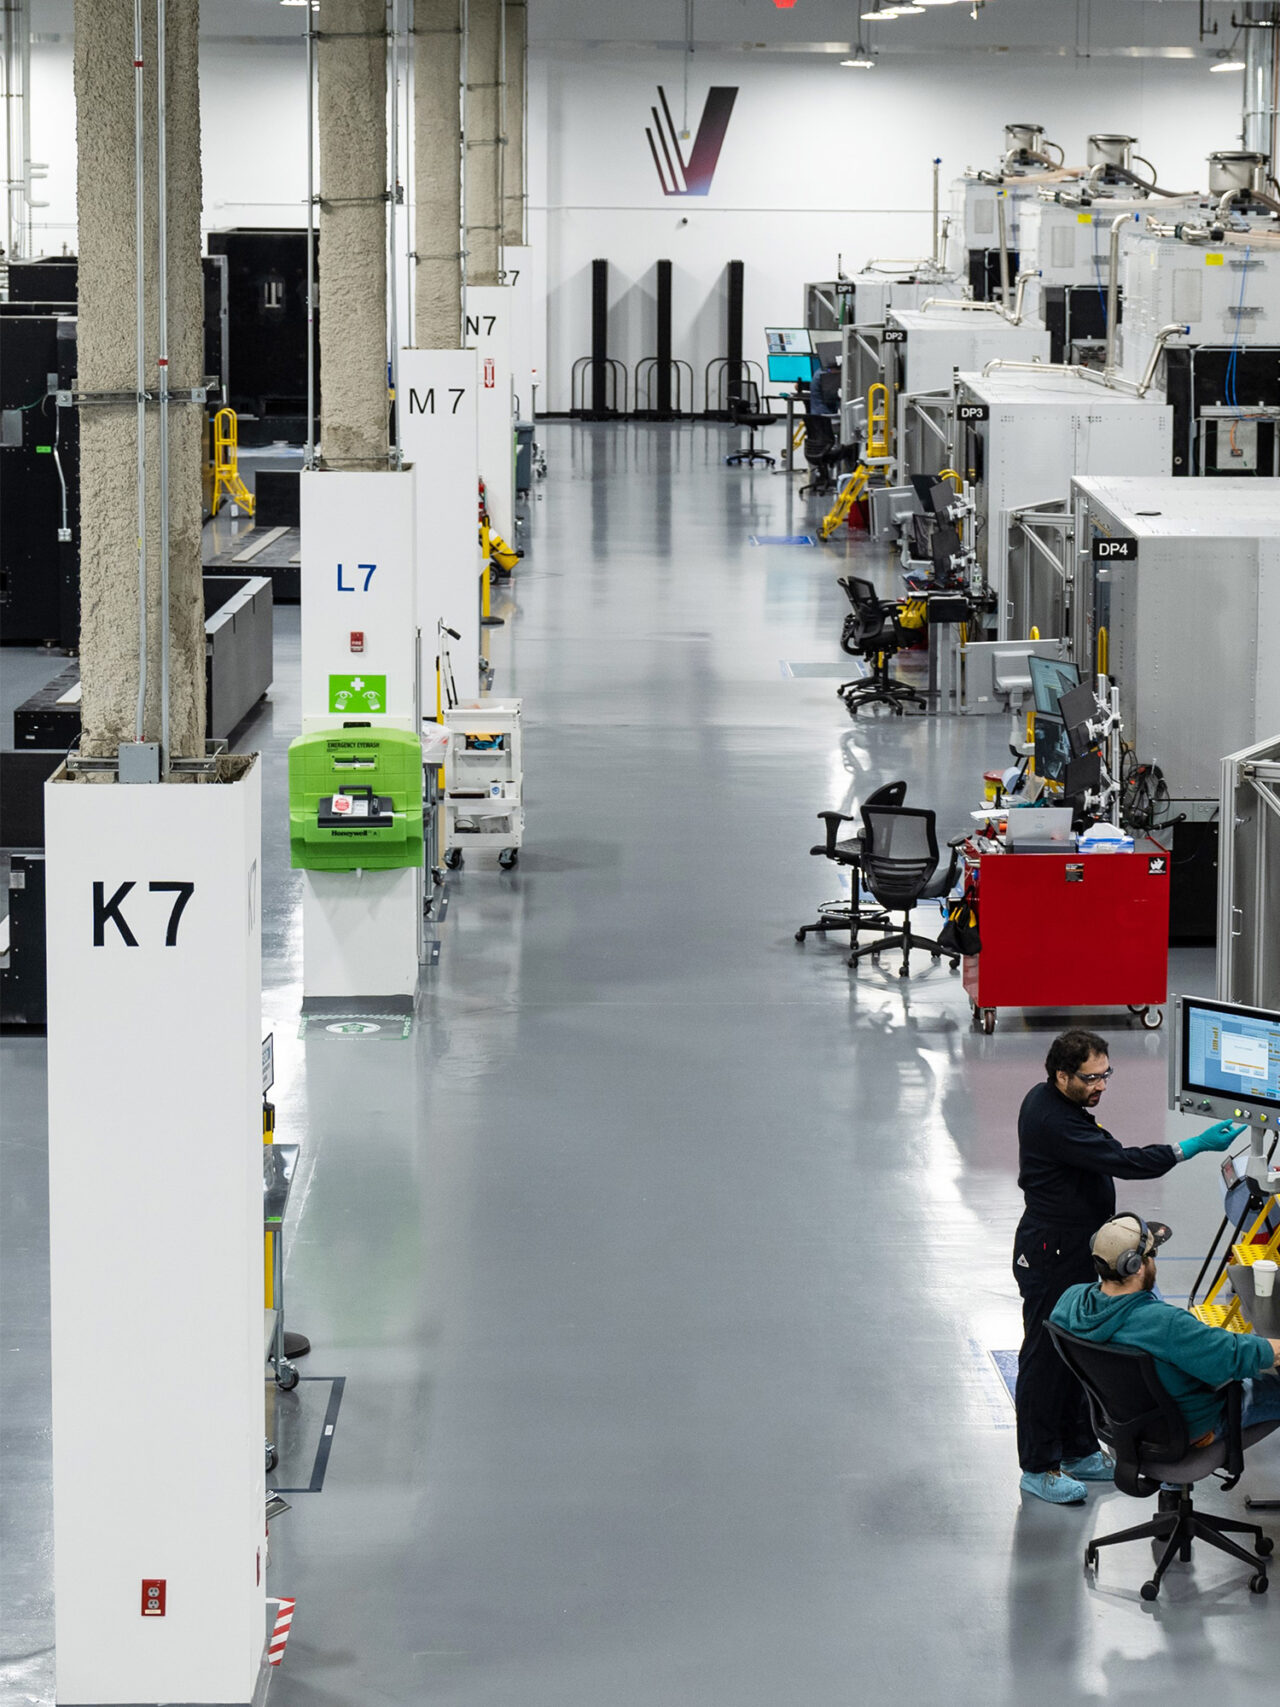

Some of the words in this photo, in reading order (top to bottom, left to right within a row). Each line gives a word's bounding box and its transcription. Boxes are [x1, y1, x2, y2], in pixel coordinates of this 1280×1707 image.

[466, 315, 497, 336] N7
[885, 332, 903, 340] DP2
[961, 407, 983, 418] DP3
[1099, 542, 1128, 556] DP4
[337, 563, 377, 592] L7
[331, 830, 368, 838] Honeywell
[92, 881, 195, 947] K7
